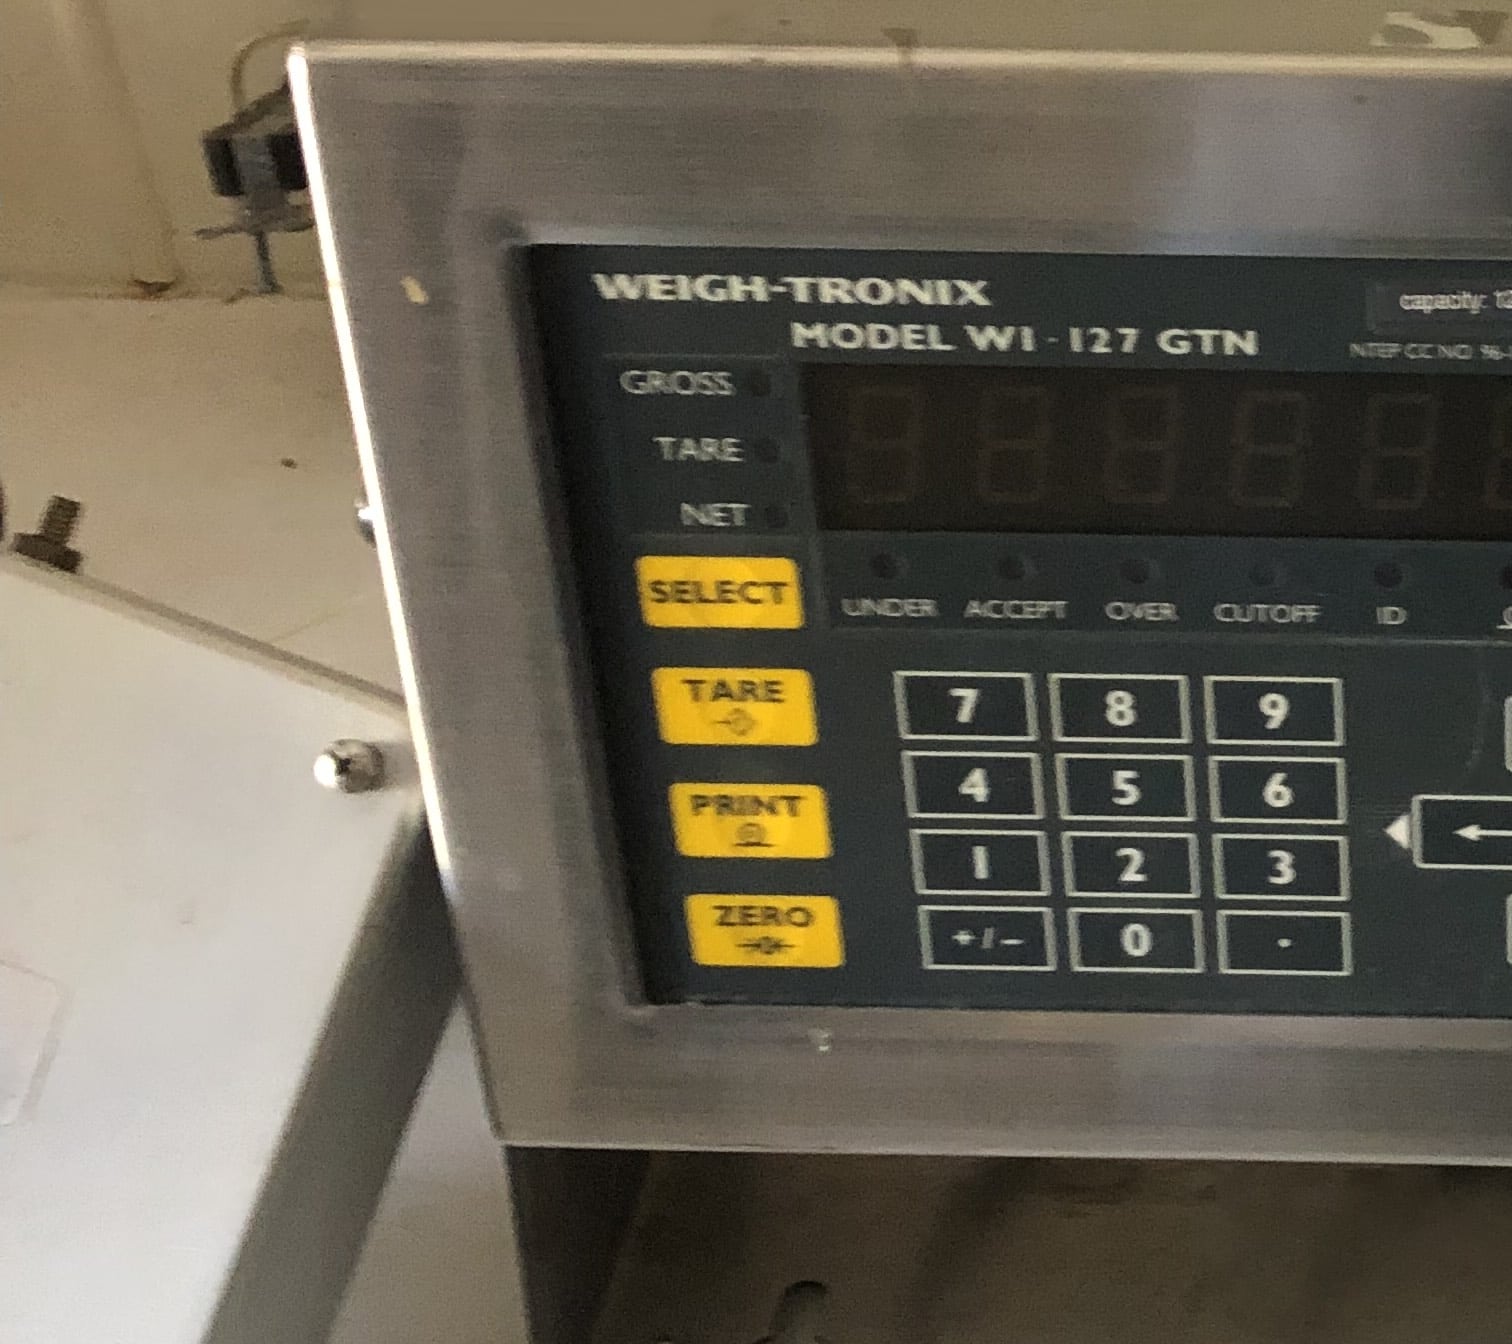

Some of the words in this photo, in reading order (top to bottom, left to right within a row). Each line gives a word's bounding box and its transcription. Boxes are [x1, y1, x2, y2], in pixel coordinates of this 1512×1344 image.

[592, 272, 992, 306] WEIGH-TRONIX
[789, 321, 958, 351] MODEL
[1156, 327, 1260, 357] GTN
[618, 369, 738, 396] GROSS
[652, 436, 746, 463] TARE
[680, 502, 751, 527] NET
[648, 580, 790, 605] SELECT
[840, 598, 939, 618] UNDER
[963, 599, 1069, 620] ACCEPT
[1104, 601, 1180, 622] OVER
[1212, 603, 1322, 624] CUTOFF
[1375, 606, 1408, 626] ID
[683, 679, 787, 703] TARE
[948, 687, 981, 724] 7
[1104, 689, 1138, 727] 8
[1257, 692, 1291, 730] 9
[957, 767, 991, 803] 4
[1111, 770, 1143, 806] 5
[1262, 772, 1295, 809] 6
[690, 794, 809, 818] PRINT
[971, 845, 991, 881] 1
[1115, 847, 1149, 883] 2
[1266, 850, 1298, 885] 3
[712, 906, 816, 929] ZERO
[1119, 923, 1154, 958] 0
